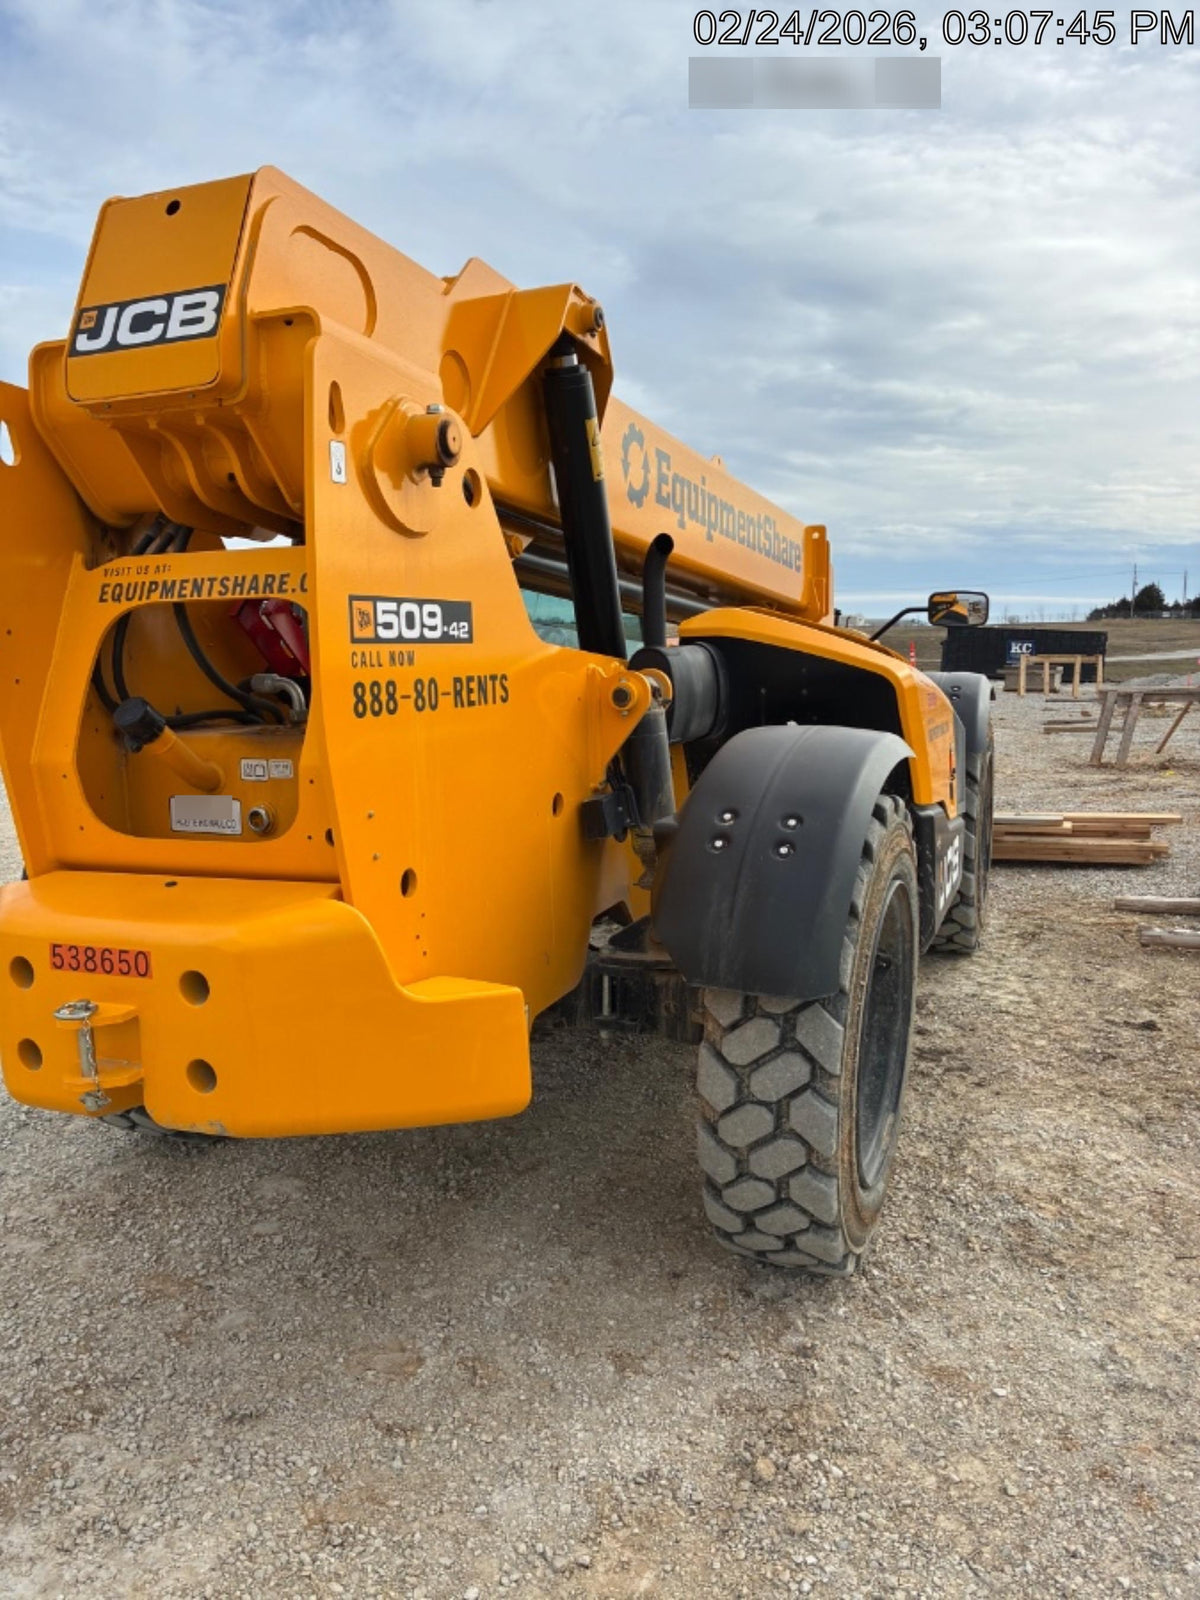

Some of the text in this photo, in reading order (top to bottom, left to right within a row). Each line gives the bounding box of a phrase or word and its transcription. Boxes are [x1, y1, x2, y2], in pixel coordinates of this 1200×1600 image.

[75, 291, 219, 351] JCB
[655, 447, 801, 573] EquipmentShare
[104, 563, 171, 577] VISIT US AT:
[351, 650, 415, 668] CALL NOW
[1010, 642, 1032, 654] KC
[353, 673, 509, 719] 888-80-RENTS
[52, 944, 149, 977] 538650
